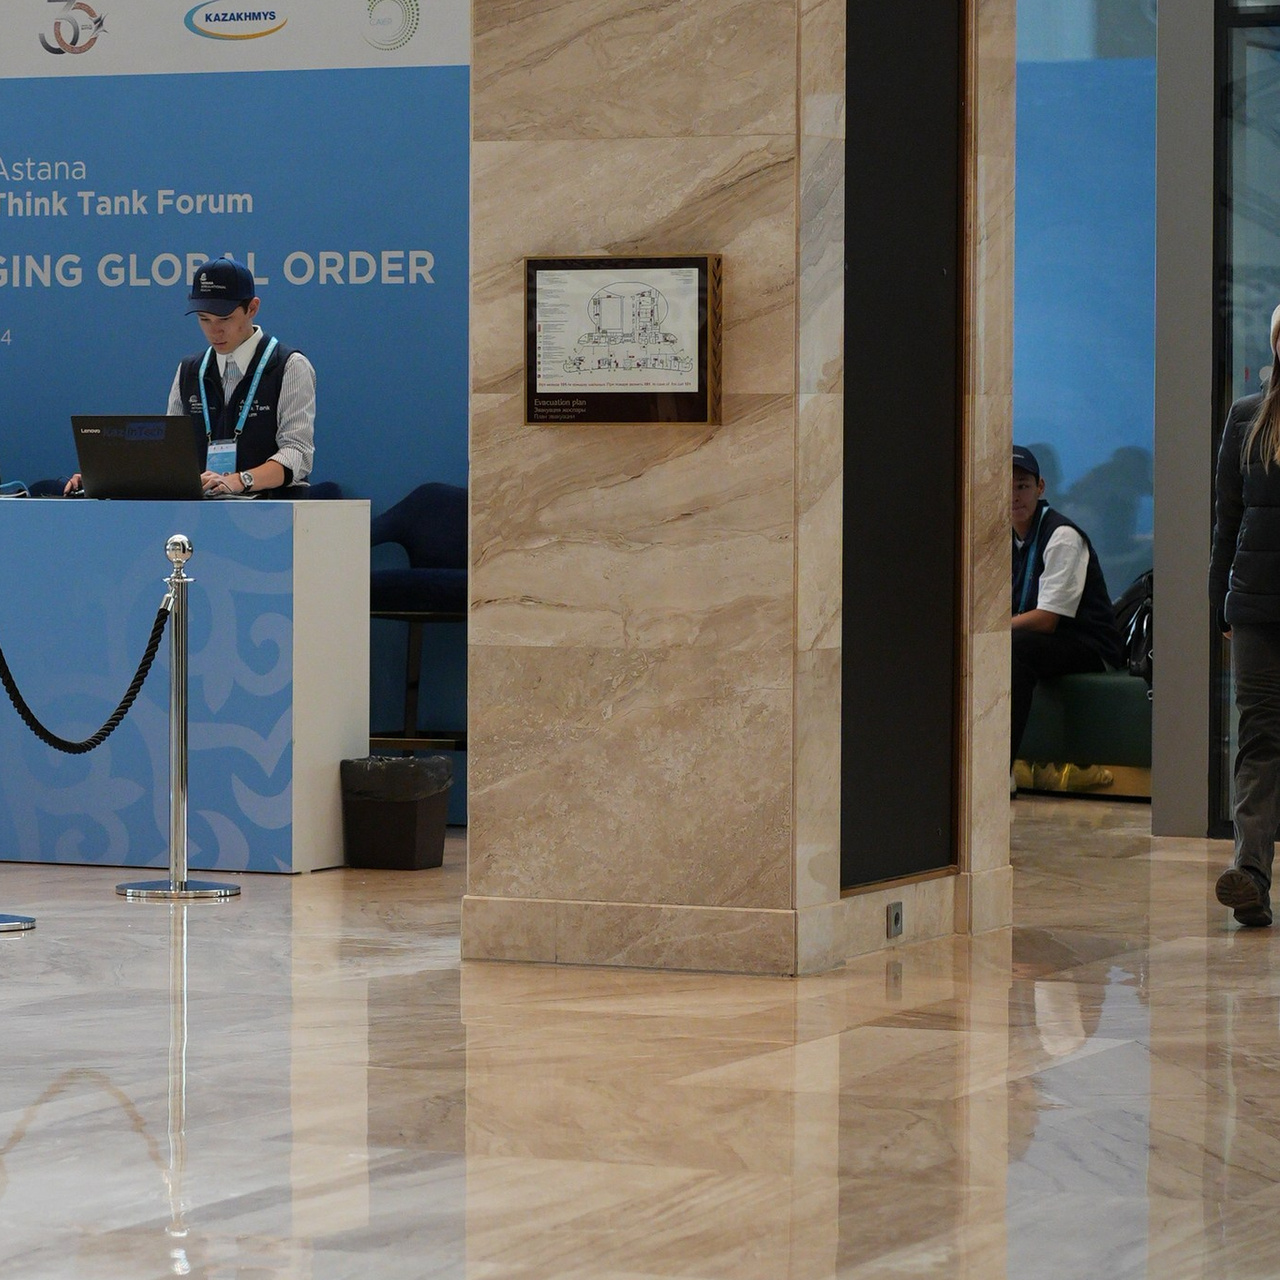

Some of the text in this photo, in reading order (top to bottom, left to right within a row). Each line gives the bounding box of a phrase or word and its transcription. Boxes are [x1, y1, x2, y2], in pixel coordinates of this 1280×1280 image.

[205, 11, 276, 23] KAZAKHMYS
[77, 191, 148, 215] Tank
[157, 189, 253, 214] Forum
[97, 252, 268, 287] GLOBL
[283, 250, 436, 285] ORDER
[572, 399, 586, 407] plan
